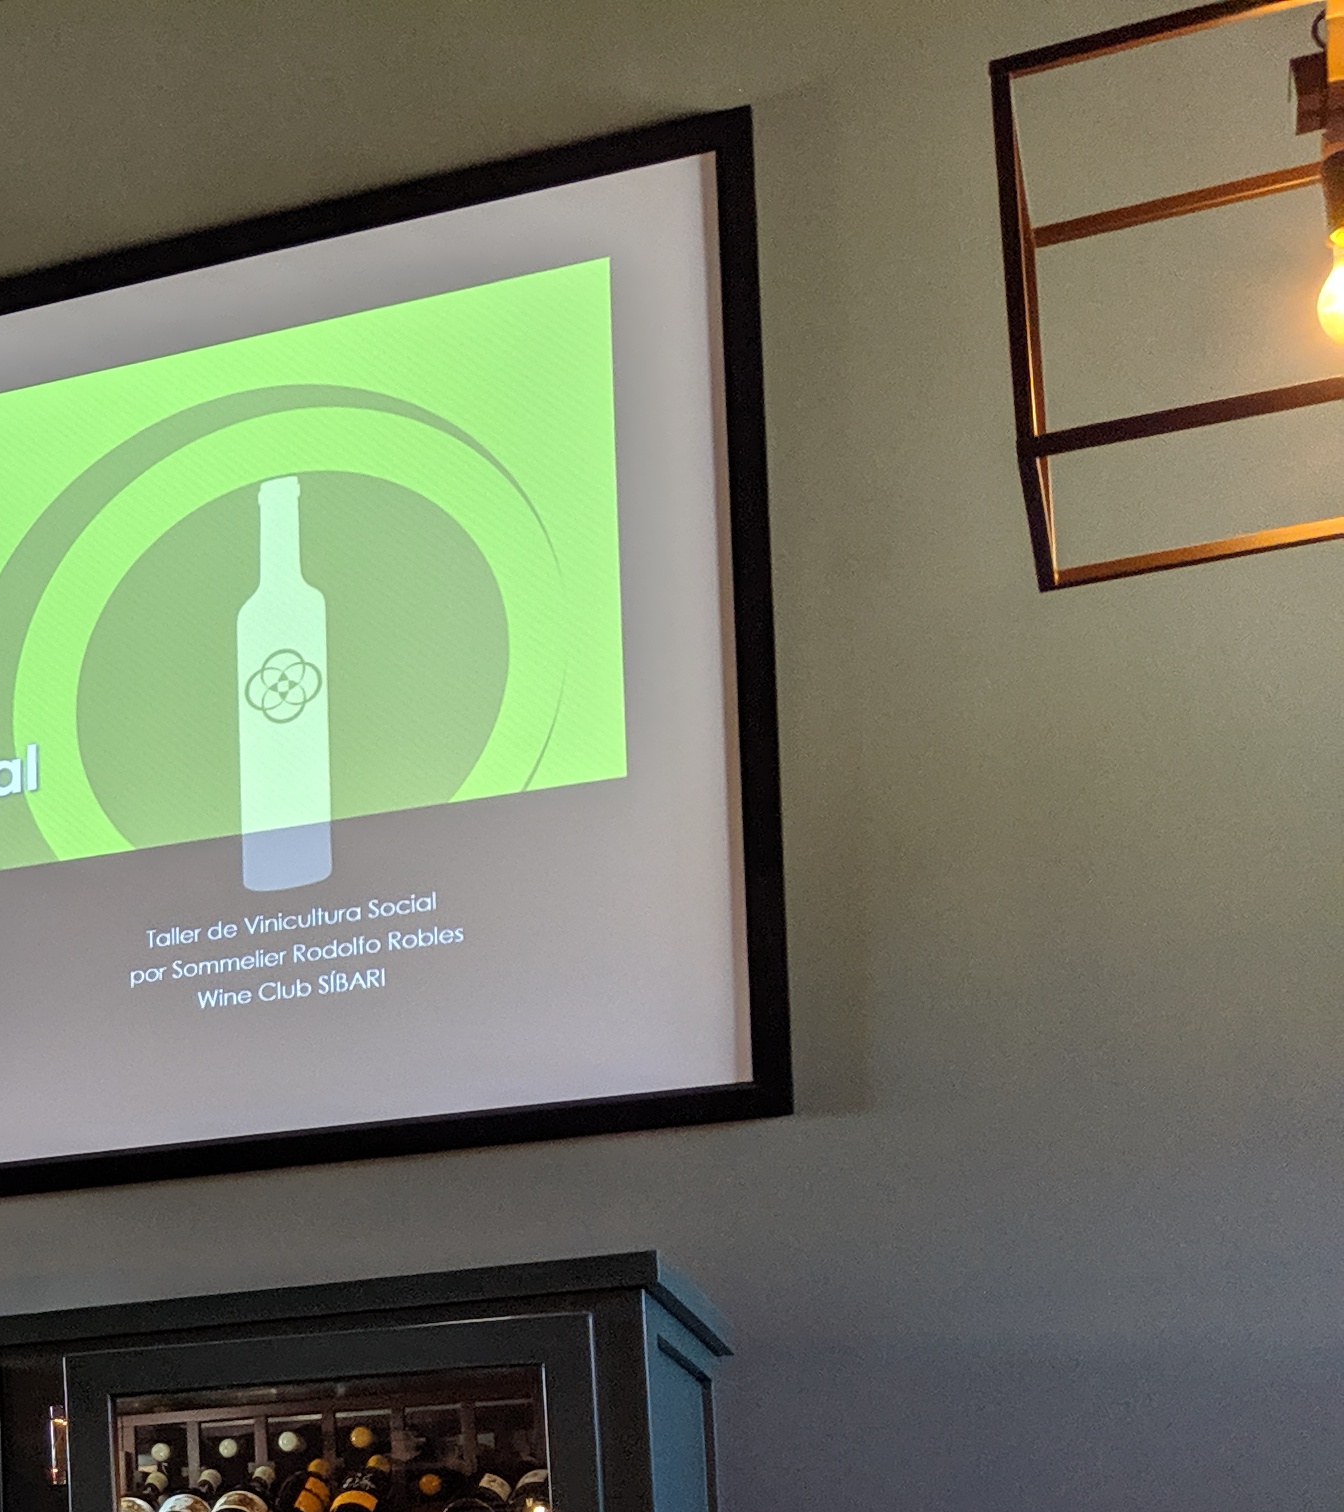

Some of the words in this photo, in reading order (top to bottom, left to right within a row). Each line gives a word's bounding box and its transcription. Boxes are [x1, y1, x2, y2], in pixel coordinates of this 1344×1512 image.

[146, 925, 201, 949] Taller
[207, 920, 238, 941] de
[244, 906, 362, 936] Vinicultura
[367, 891, 438, 919] Social
[129, 963, 165, 988] por
[171, 949, 287, 980] Sommelier
[292, 935, 381, 964] Rodolfo
[388, 925, 465, 952] Robles
[197, 989, 253, 1009] Wine
[258, 977, 312, 1001] Club
[318, 968, 387, 995] SÍBARI
